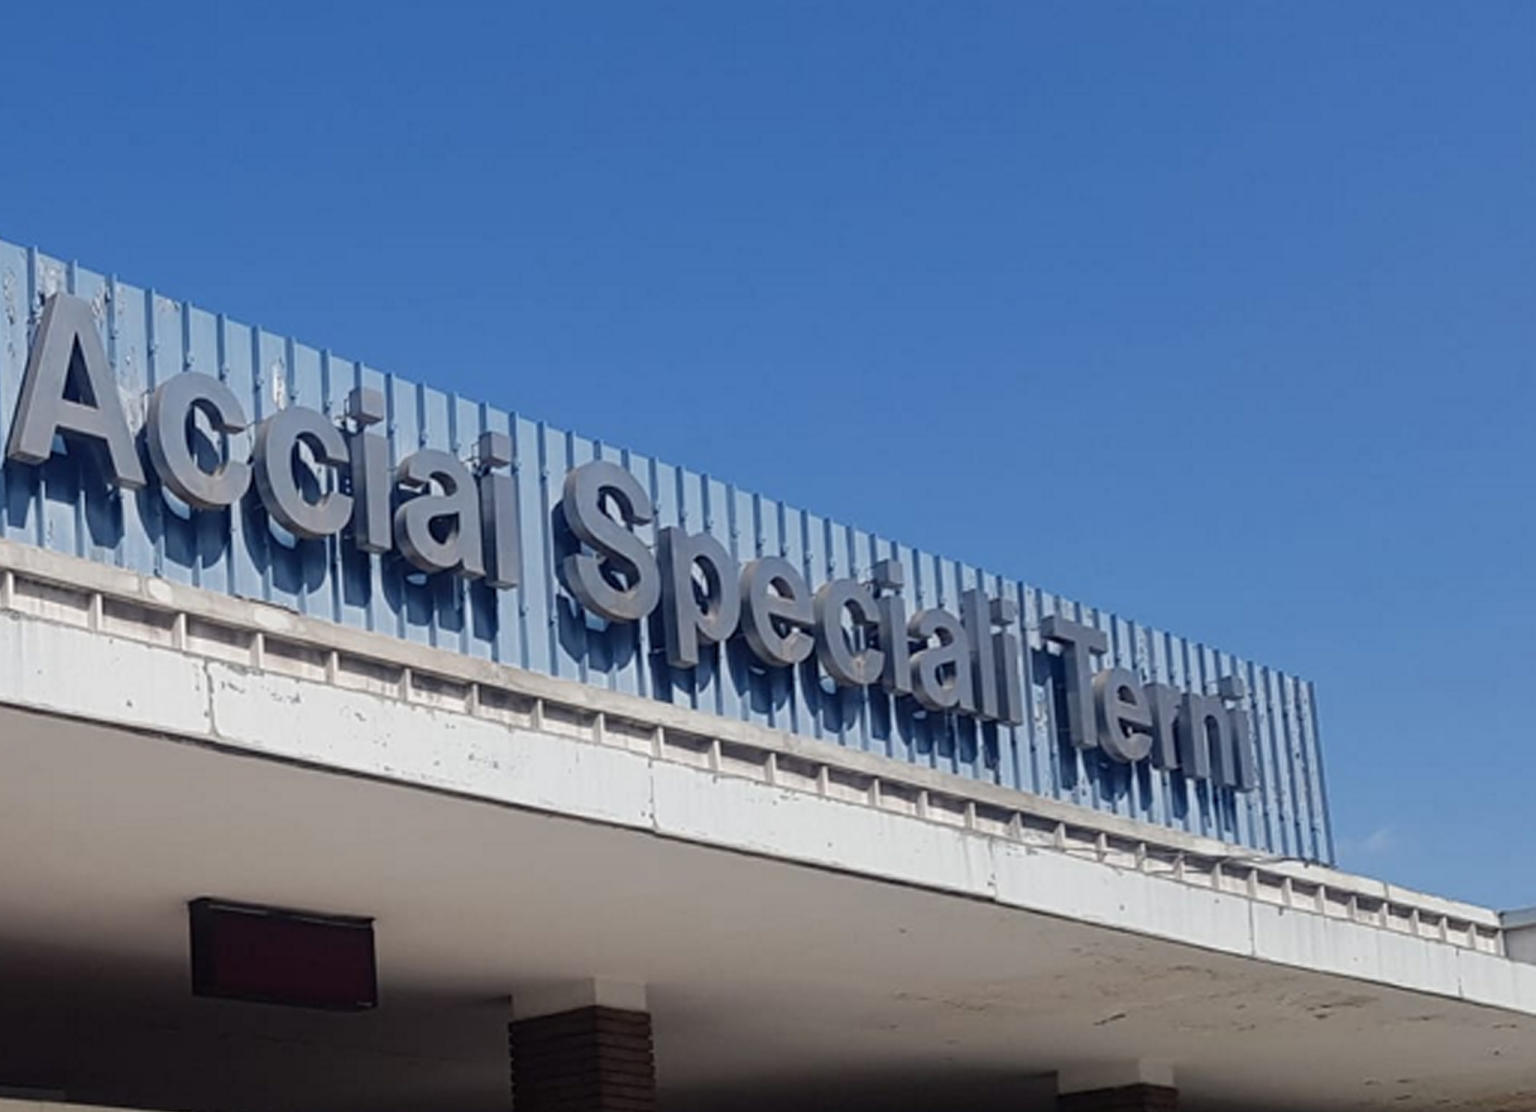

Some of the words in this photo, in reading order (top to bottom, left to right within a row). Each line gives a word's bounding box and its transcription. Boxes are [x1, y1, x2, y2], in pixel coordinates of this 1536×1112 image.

[7, 291, 519, 590] Acciai
[562, 460, 1022, 728] Speciali
[1039, 614, 1256, 792] Terni
